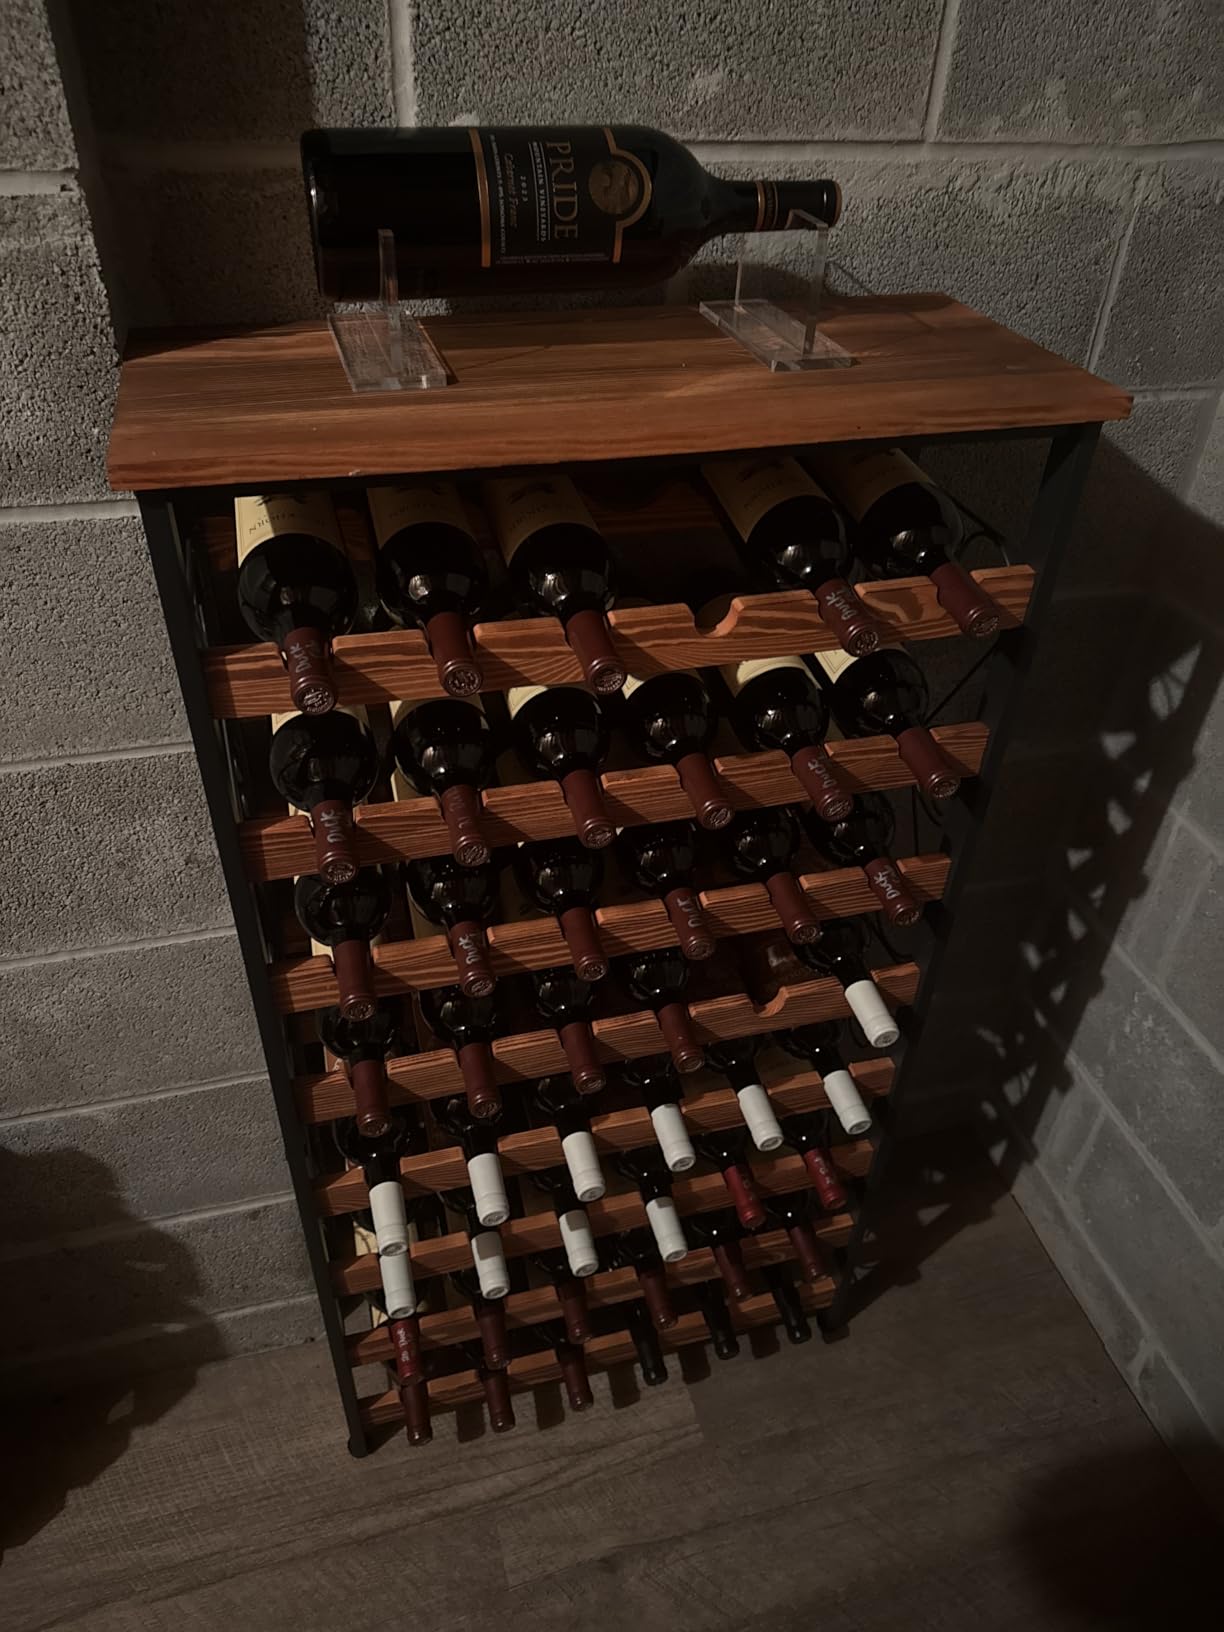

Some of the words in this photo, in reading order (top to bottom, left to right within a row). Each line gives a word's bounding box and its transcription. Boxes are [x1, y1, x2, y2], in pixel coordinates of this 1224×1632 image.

[533, 141, 545, 185] MOUNTAIN
[539, 189, 547, 241] VINEYARDS
[546, 140, 577, 239] PRIDE
[826, 592, 857, 620] Duck
[290, 642, 312, 673] Duck
[808, 759, 837, 789] Duck
[320, 809, 346, 843] Duck
[873, 871, 901, 900] Duck
[459, 933, 481, 964] Duck
